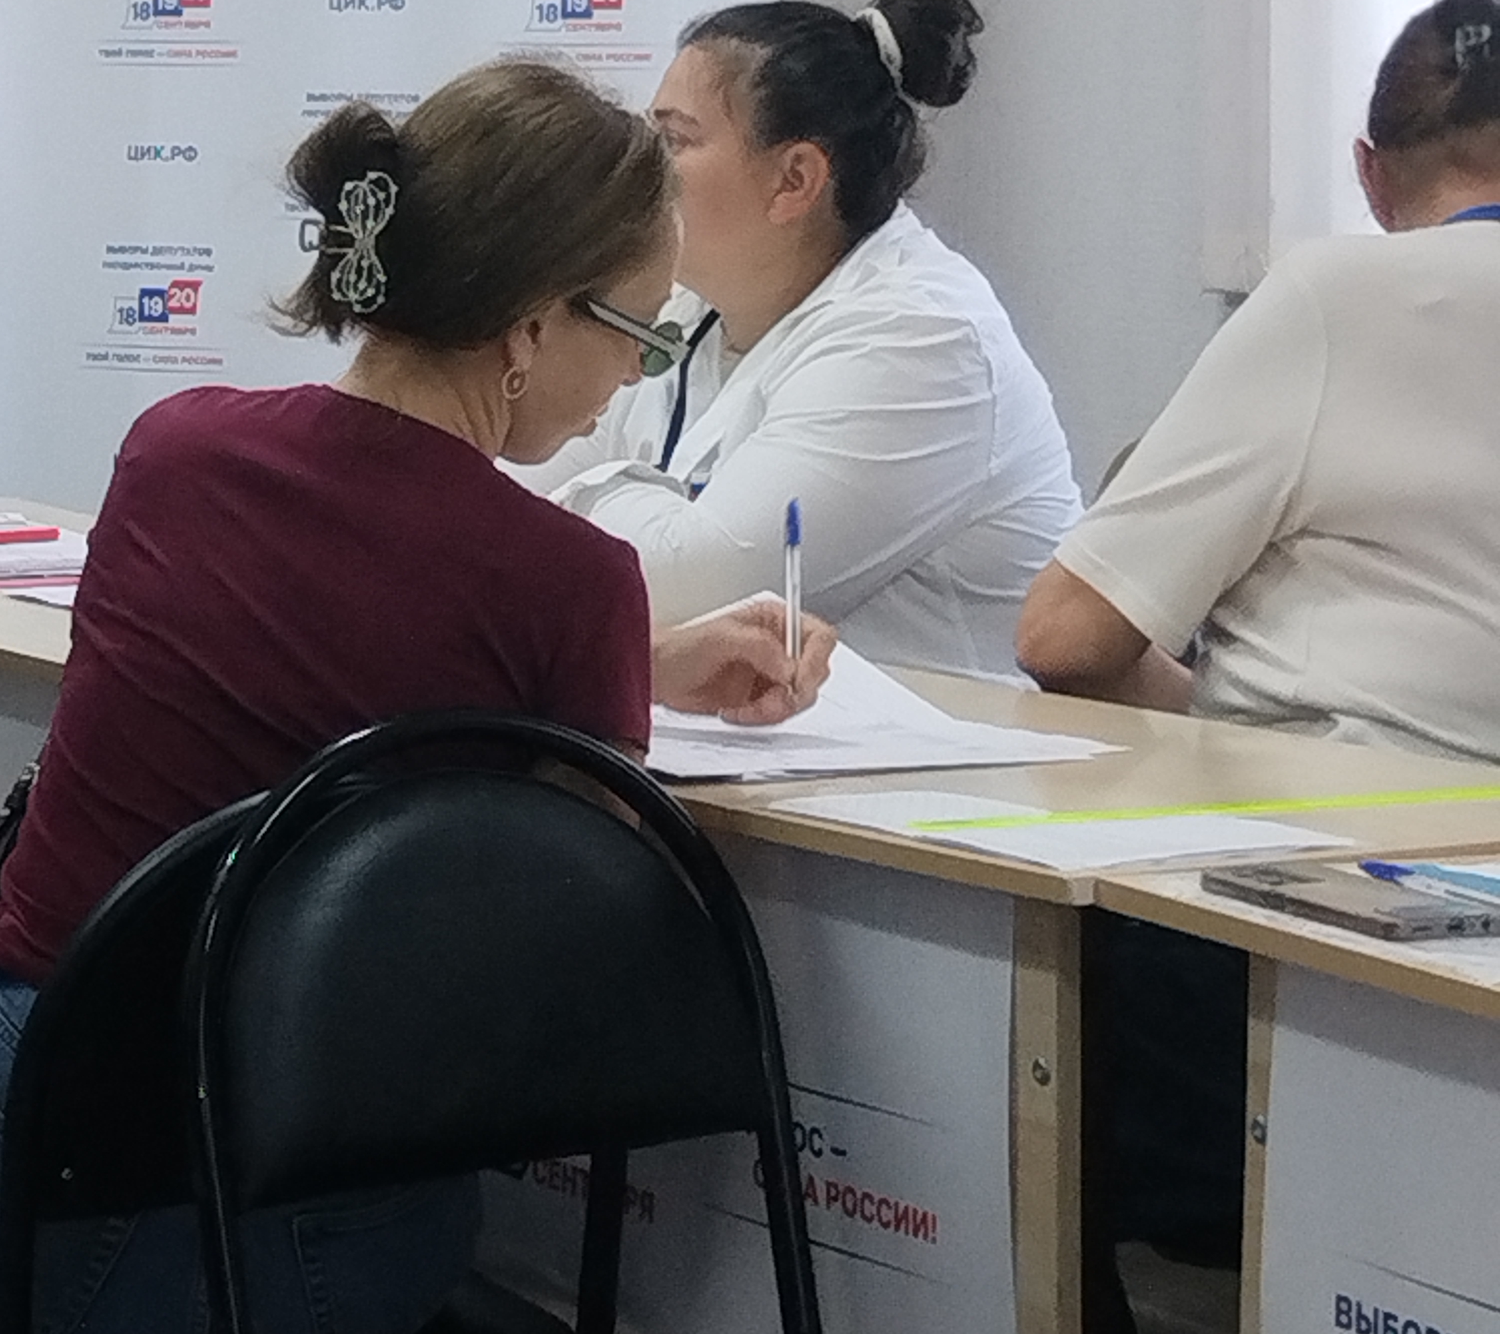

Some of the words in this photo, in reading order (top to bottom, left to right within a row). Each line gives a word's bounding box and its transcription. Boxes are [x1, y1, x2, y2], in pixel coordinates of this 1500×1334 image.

[132, 1, 151, 21] 18
[535, 3, 558, 23] 18
[127, 145, 199, 163] ЦИК.РФ
[141, 295, 163, 317] 19
[168, 287, 195, 309] 20
[117, 306, 137, 326] 18
[825, 1179, 938, 1245] РОССИИ!
